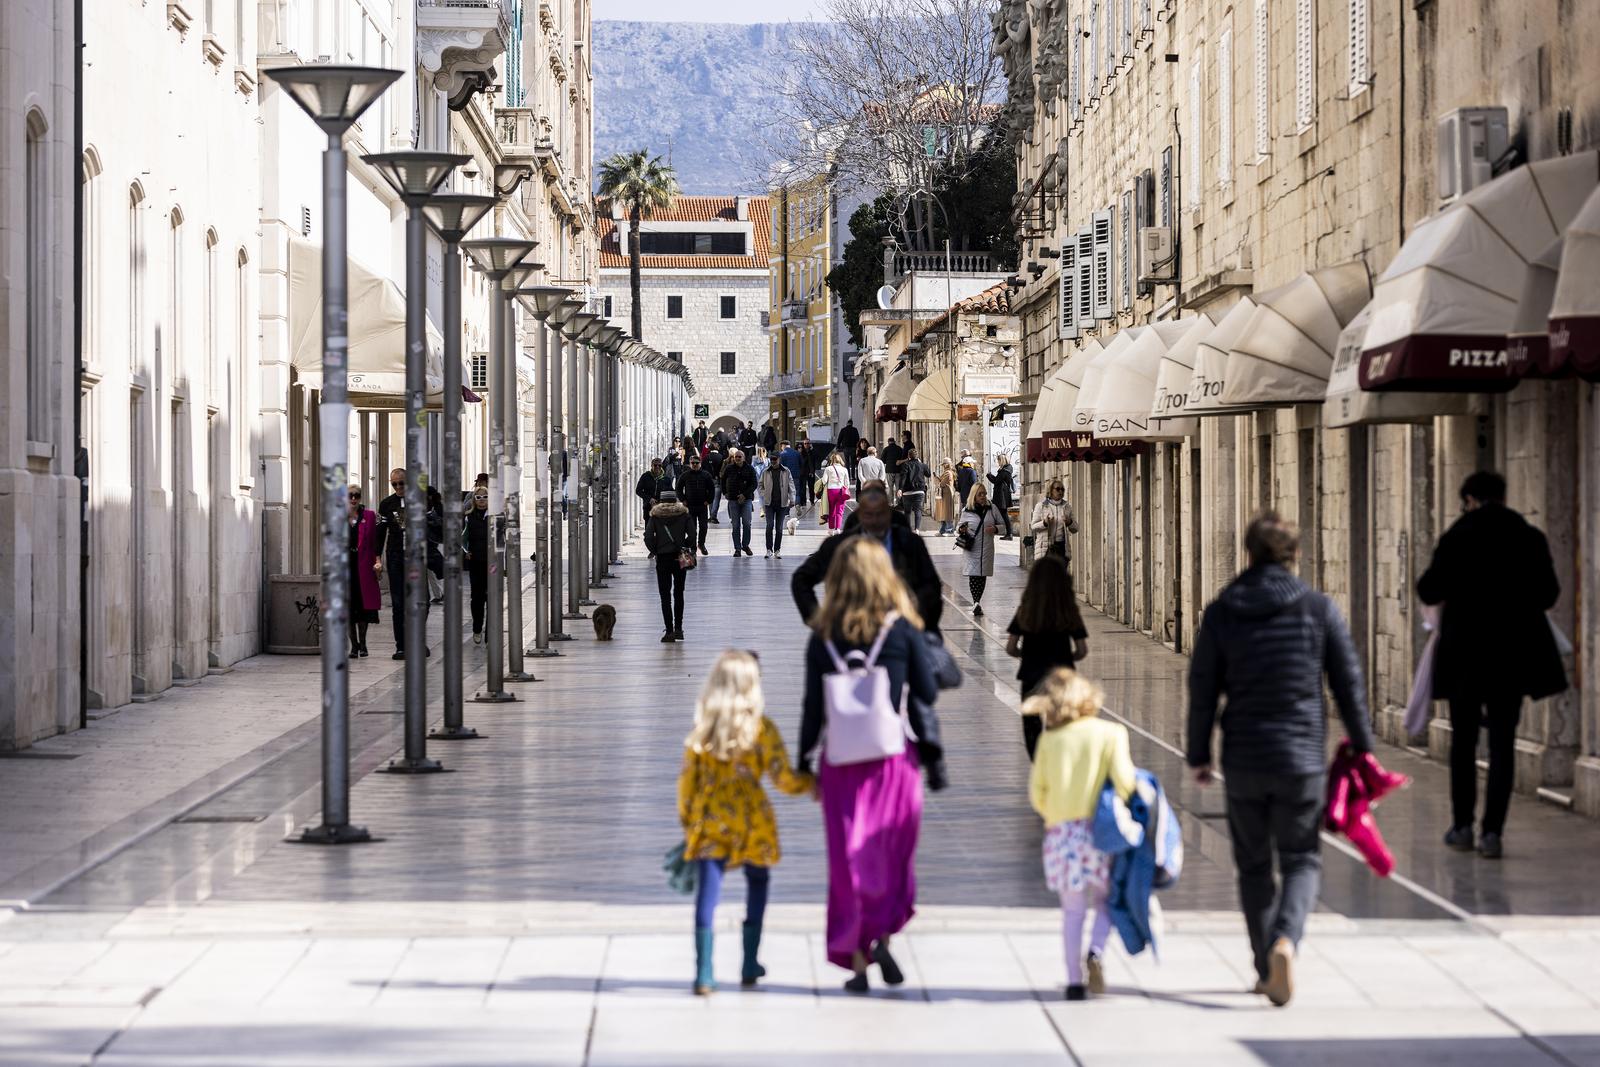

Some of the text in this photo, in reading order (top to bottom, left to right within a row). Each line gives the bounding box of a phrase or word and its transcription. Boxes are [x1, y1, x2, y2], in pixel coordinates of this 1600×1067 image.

[1449, 348, 1508, 366] PIZZA
[1097, 418, 1171, 433] GANT
[1048, 437, 1072, 449] KRUNA
